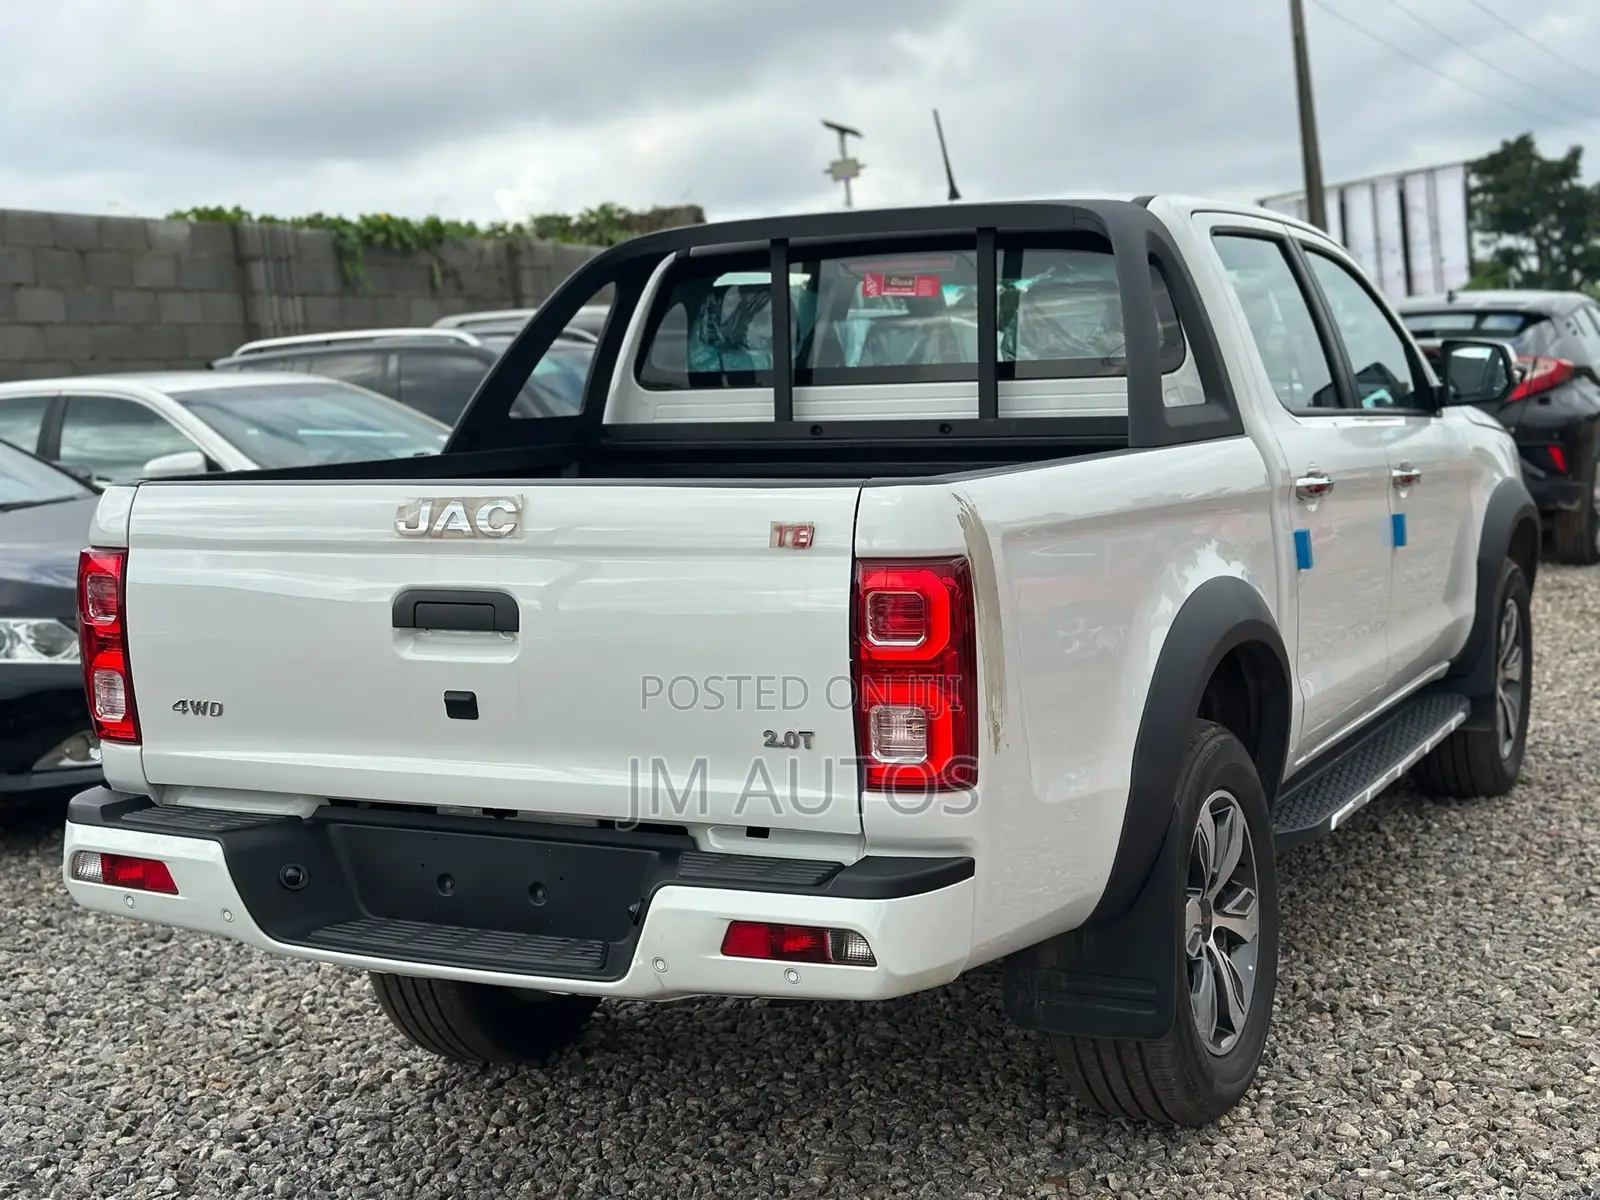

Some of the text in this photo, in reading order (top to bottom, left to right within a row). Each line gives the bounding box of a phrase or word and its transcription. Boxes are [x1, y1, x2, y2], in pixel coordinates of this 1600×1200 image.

[397, 500, 519, 538] JAC
[172, 698, 224, 717] 4WD
[763, 729, 815, 750] 2.0T
